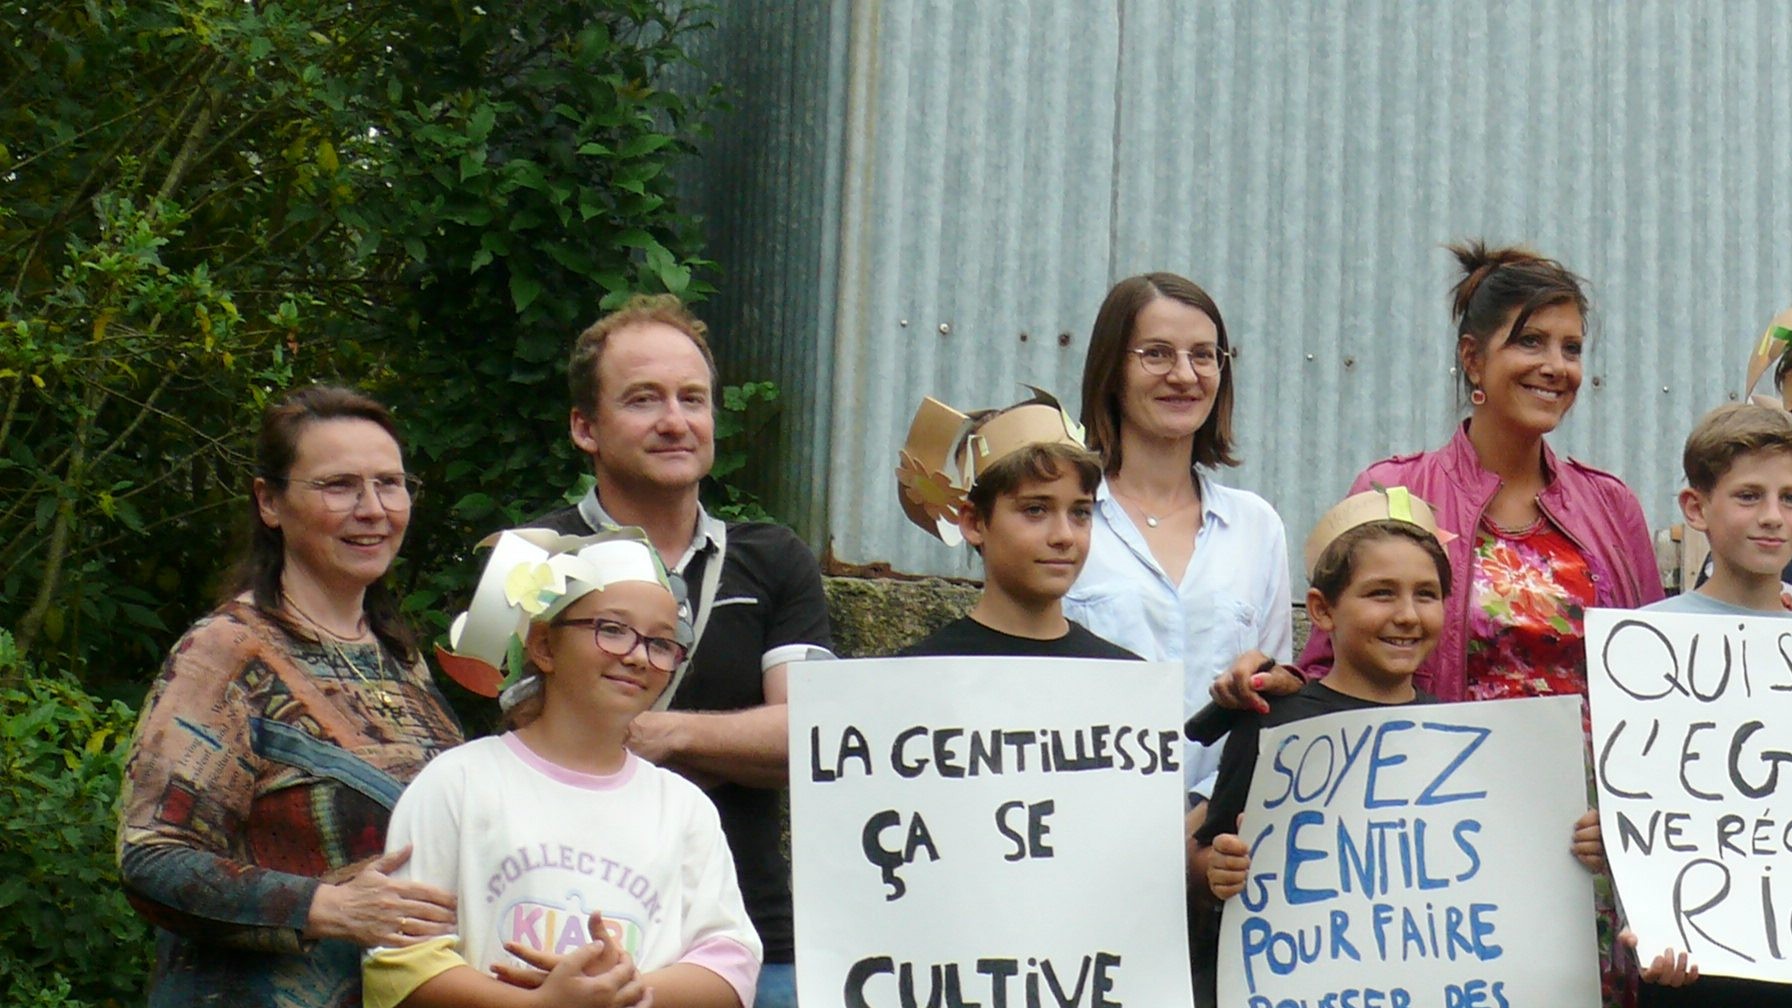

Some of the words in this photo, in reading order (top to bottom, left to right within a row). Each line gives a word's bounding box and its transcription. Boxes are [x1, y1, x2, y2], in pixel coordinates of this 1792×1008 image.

[810, 724, 873, 782] LA
[1263, 719, 1492, 809] SOYEZ
[861, 808, 940, 902] ÇA
[994, 799, 1055, 861] SE
[1616, 810, 1699, 857] NE
[487, 842, 663, 921] COLLECTION
[1241, 910, 1361, 995] POUR
